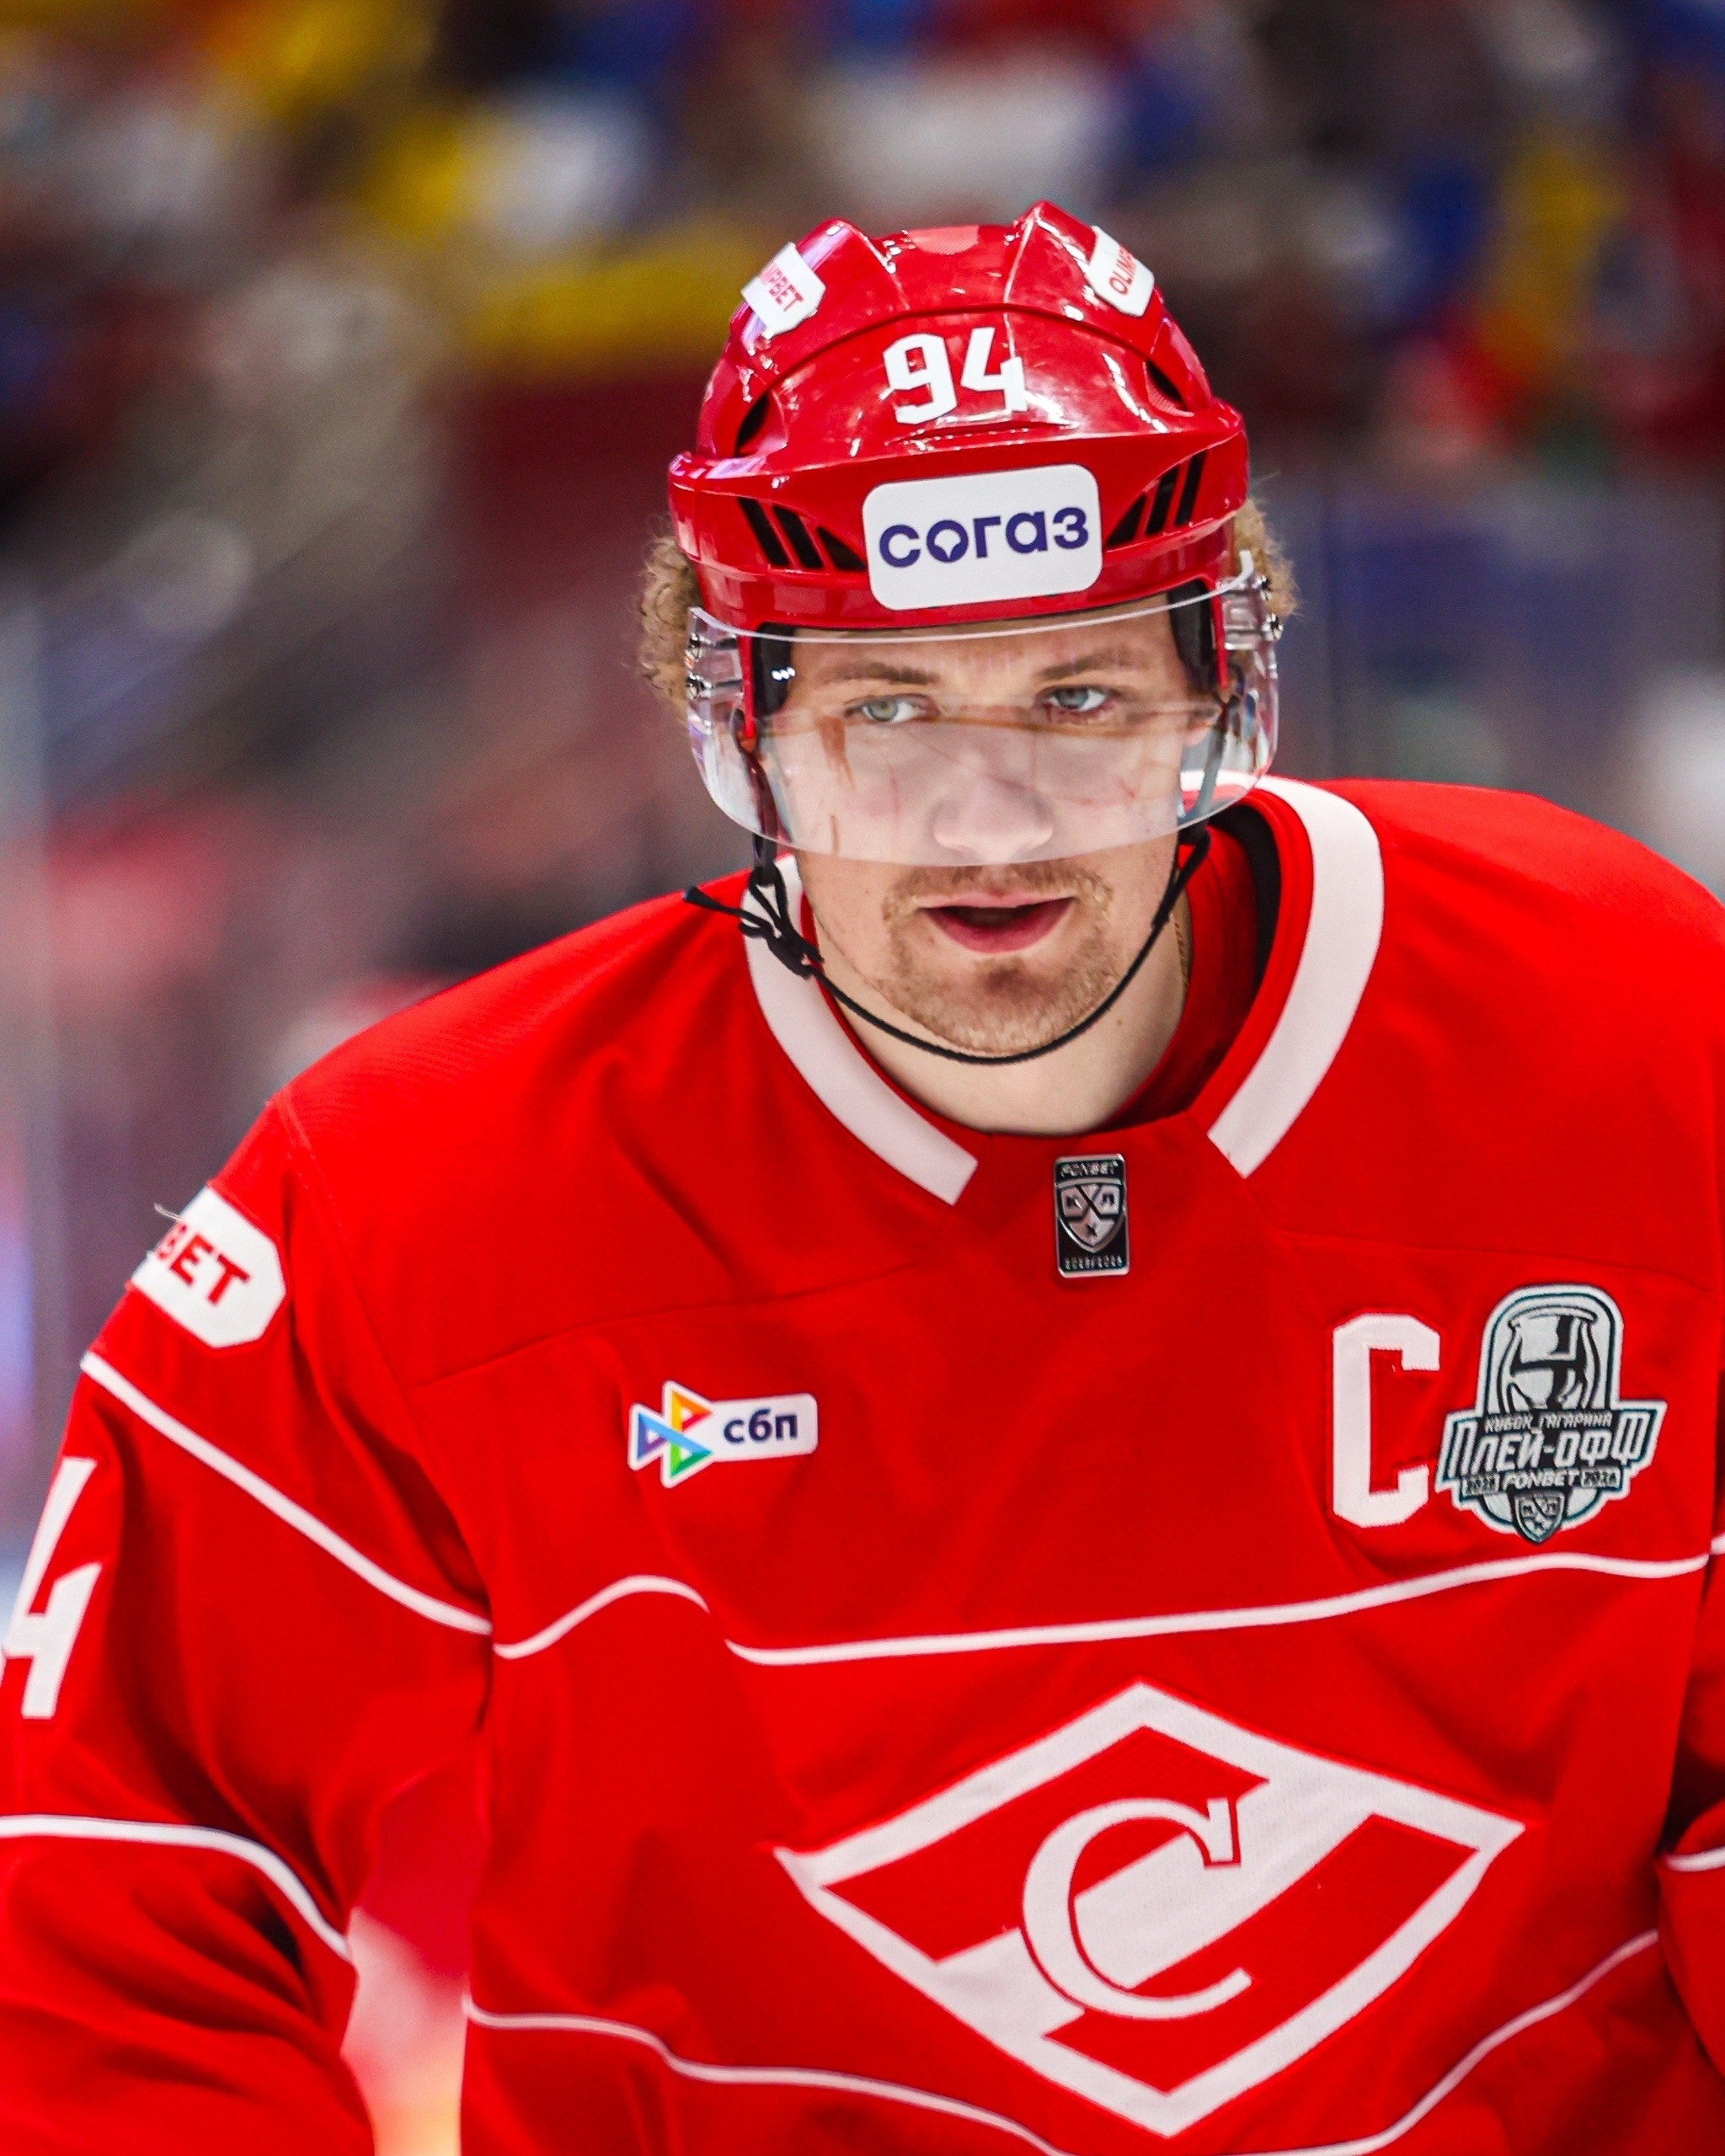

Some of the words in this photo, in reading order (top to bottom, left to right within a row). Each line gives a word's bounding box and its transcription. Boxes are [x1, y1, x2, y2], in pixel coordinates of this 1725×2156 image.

[883, 327, 1028, 424] 94
[1483, 1412, 1534, 1433] КУБОК
[1538, 1411, 1613, 1429] ГАГАРИНА
[1448, 1411, 1652, 1479] ПЛЕЙ-ОФФ
[1502, 1468, 1580, 1491] FONBET
